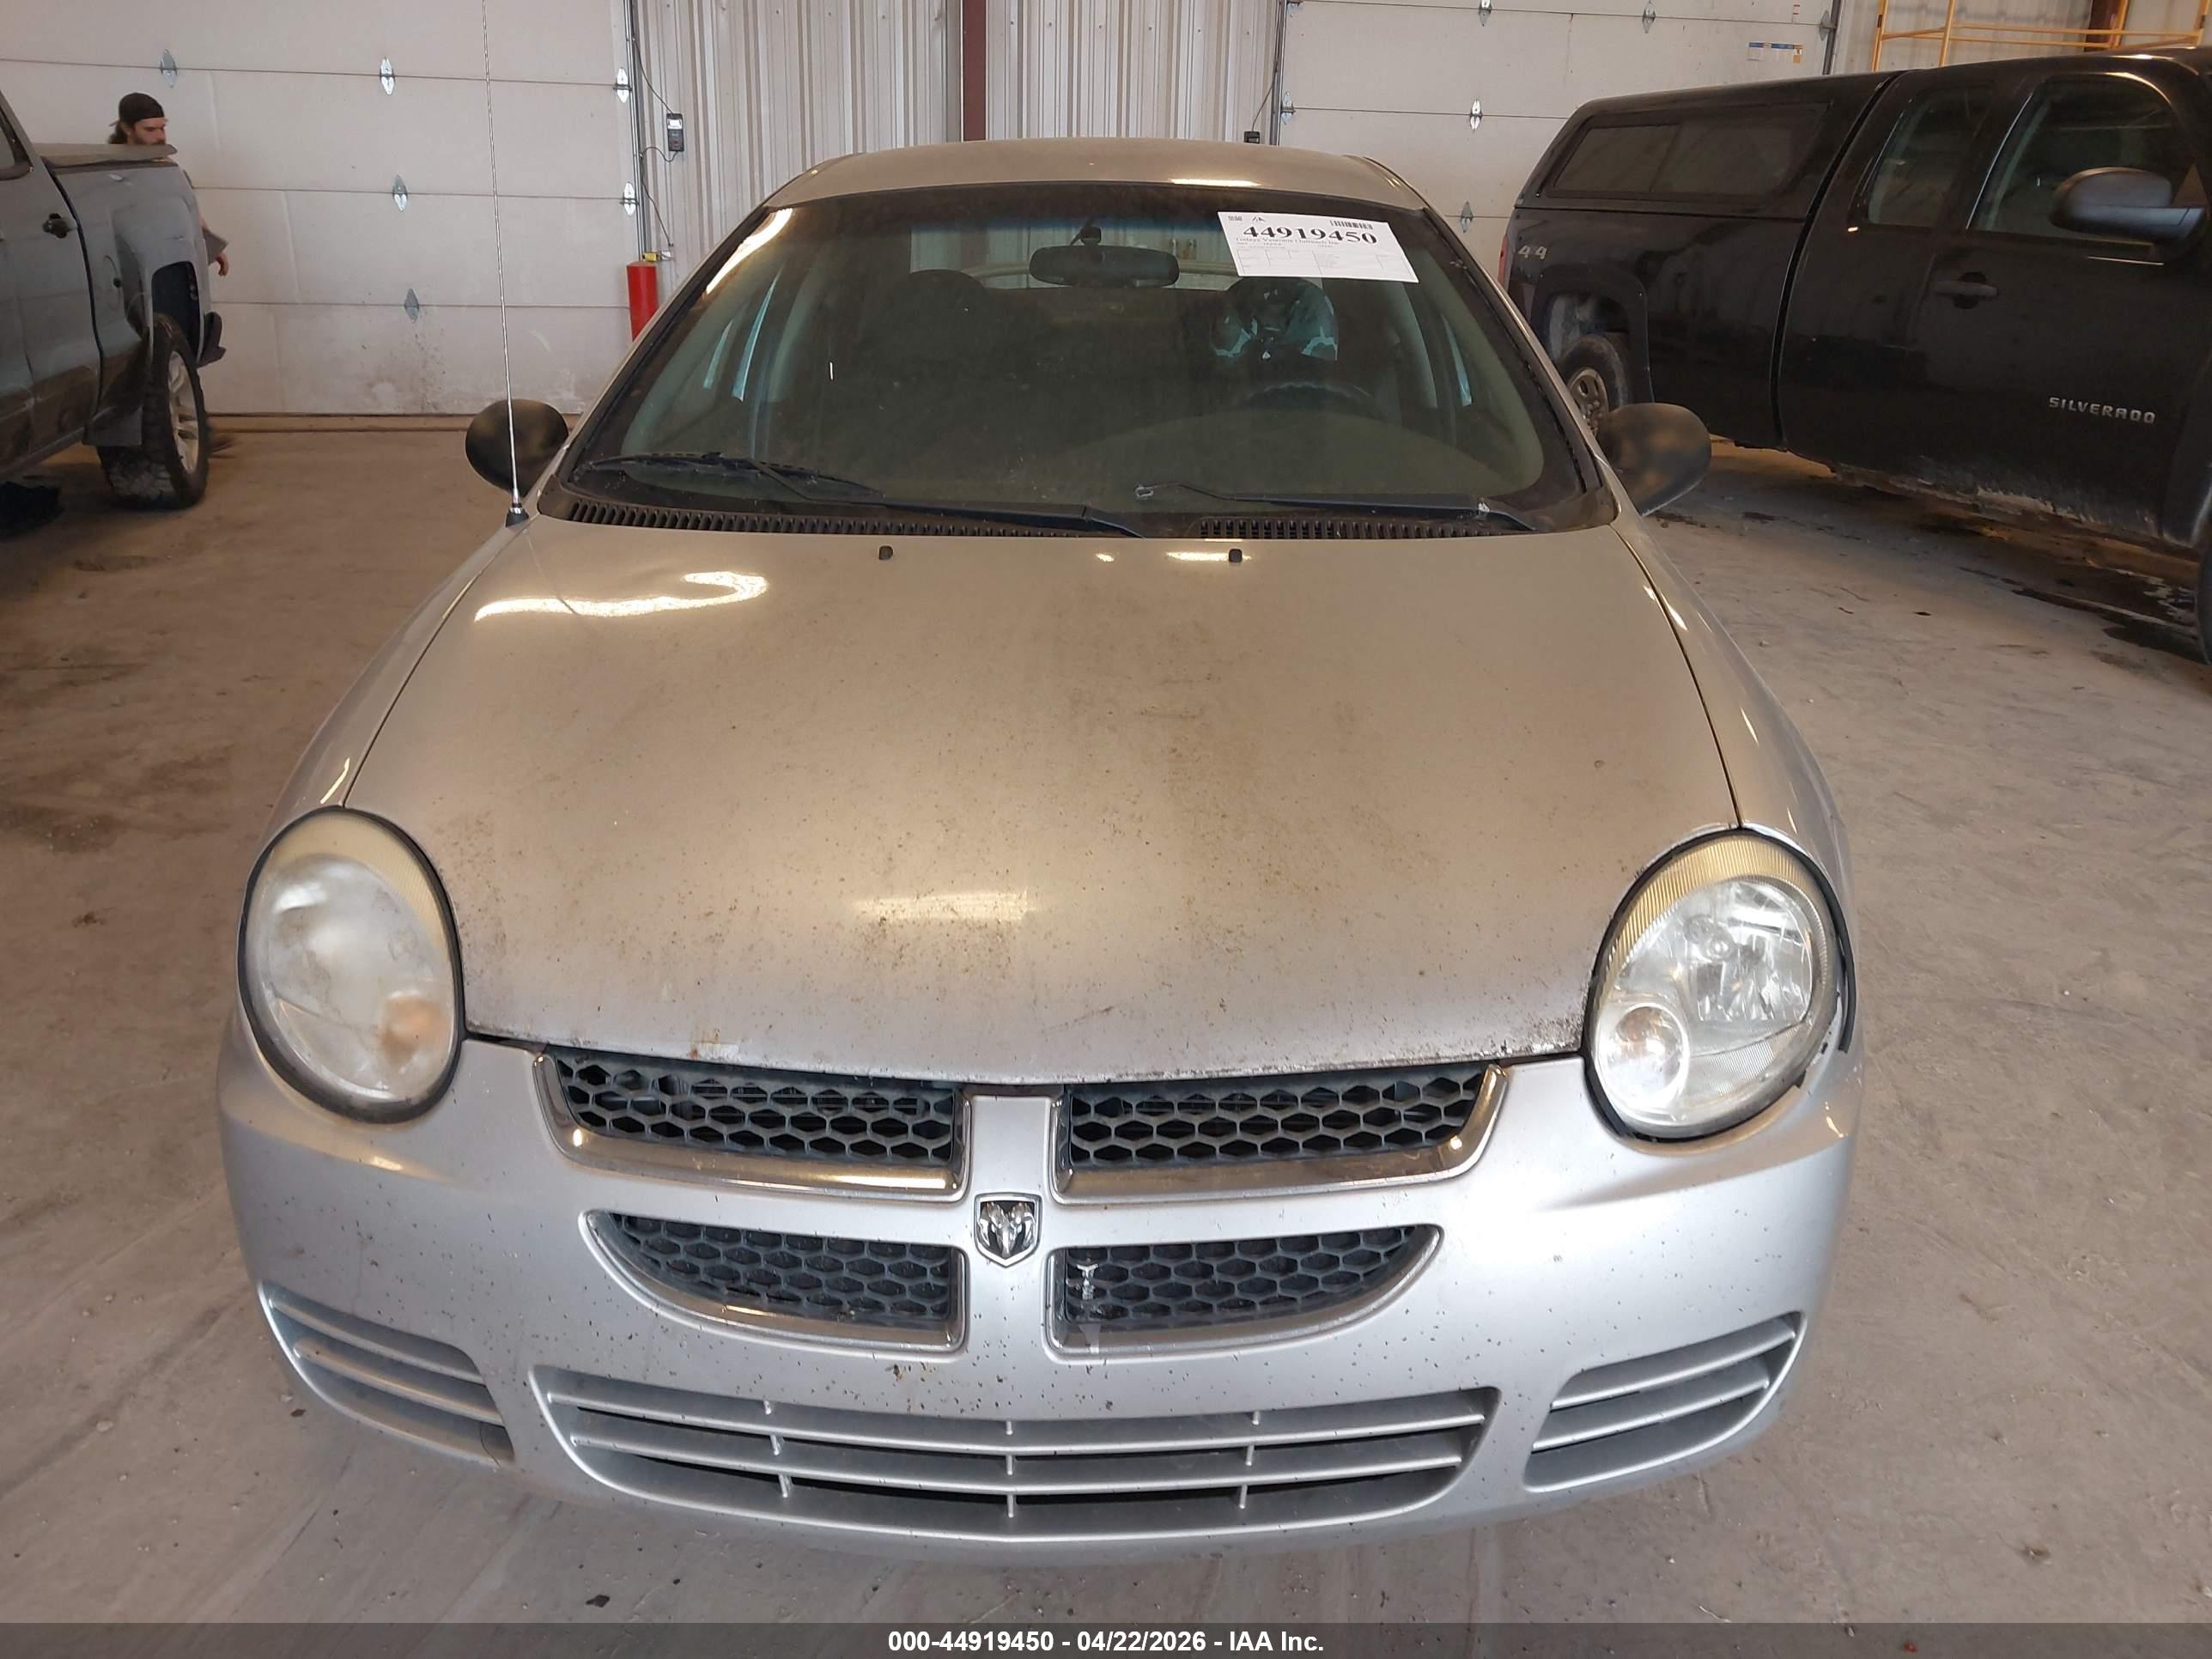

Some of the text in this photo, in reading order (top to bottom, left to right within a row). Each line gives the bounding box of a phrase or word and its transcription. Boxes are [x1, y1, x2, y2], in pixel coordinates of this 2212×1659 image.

[1243, 225, 1377, 245] 44919450
[1518, 245, 1547, 259] 44
[2049, 397, 2155, 424] SILVERADO
